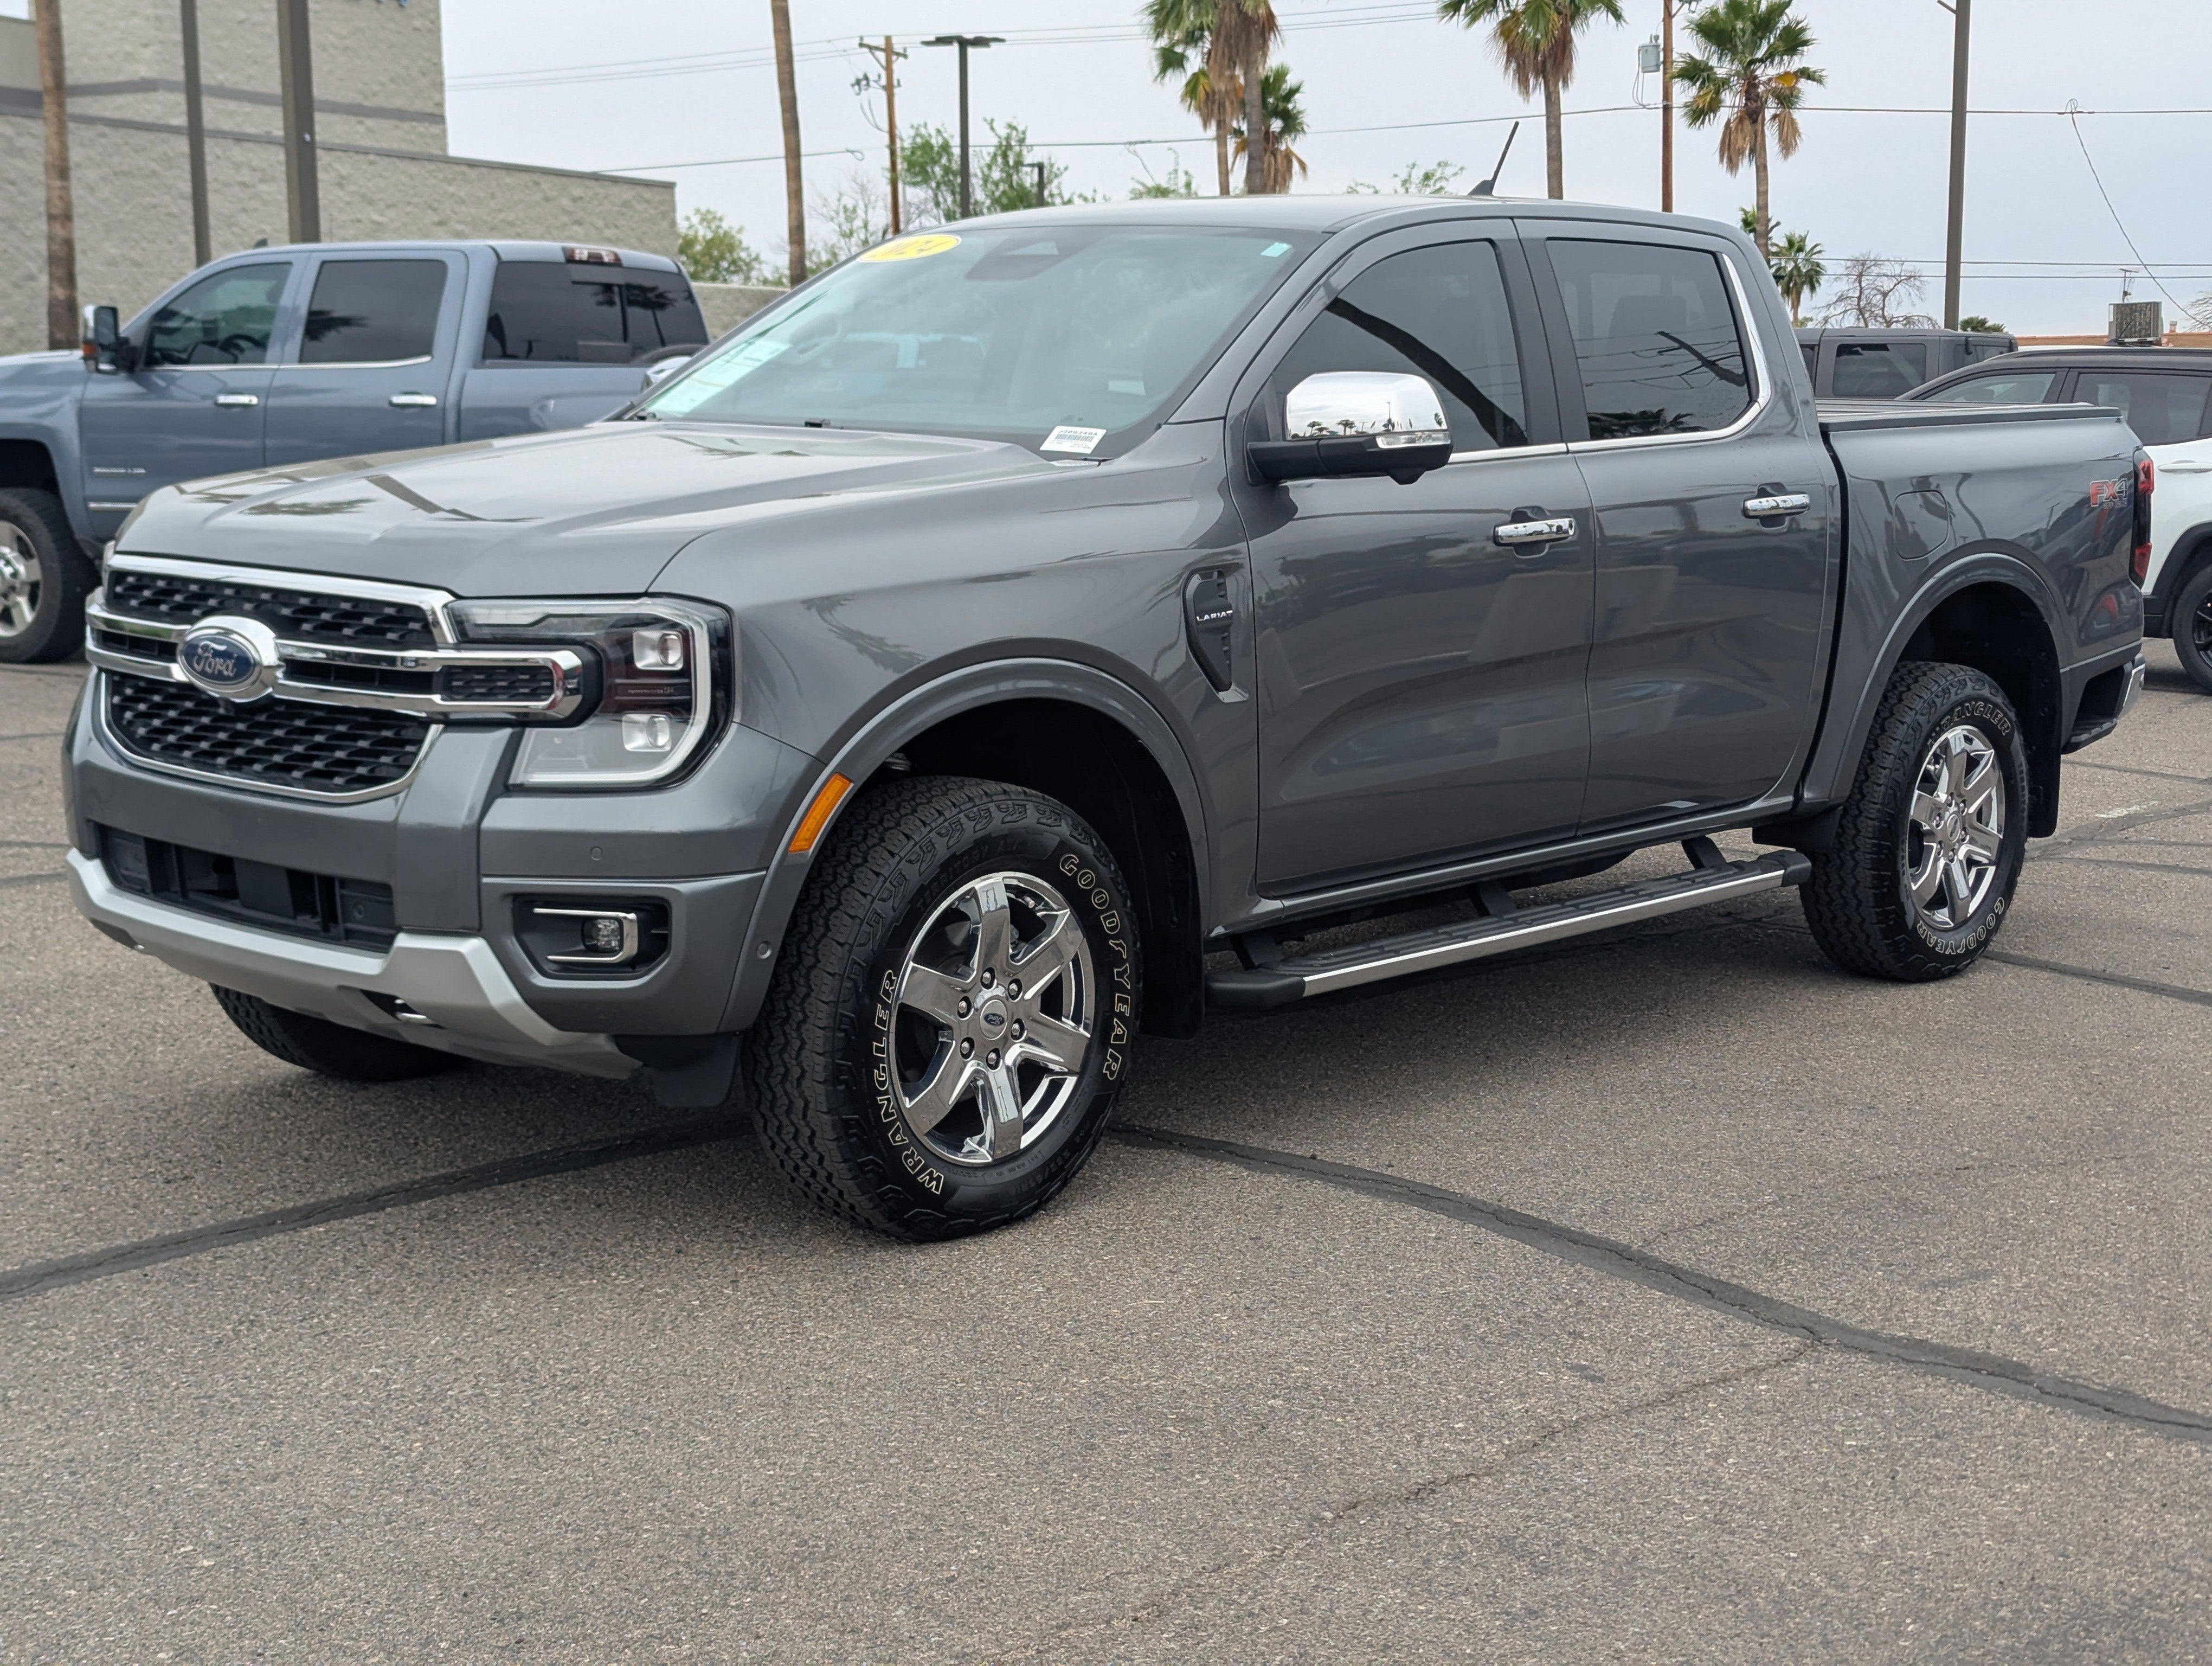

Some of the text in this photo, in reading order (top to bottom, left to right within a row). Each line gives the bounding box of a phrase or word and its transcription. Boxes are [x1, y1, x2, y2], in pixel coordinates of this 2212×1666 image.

[2089, 478, 2128, 507] FX4
[1196, 610, 1233, 622] LARIAT
[192, 640, 237, 677] Ford
[1917, 896, 2004, 954] GOODYEAR
[1059, 854, 1130, 1080] GOODYEAR
[873, 970, 944, 1195] WRANGLER
